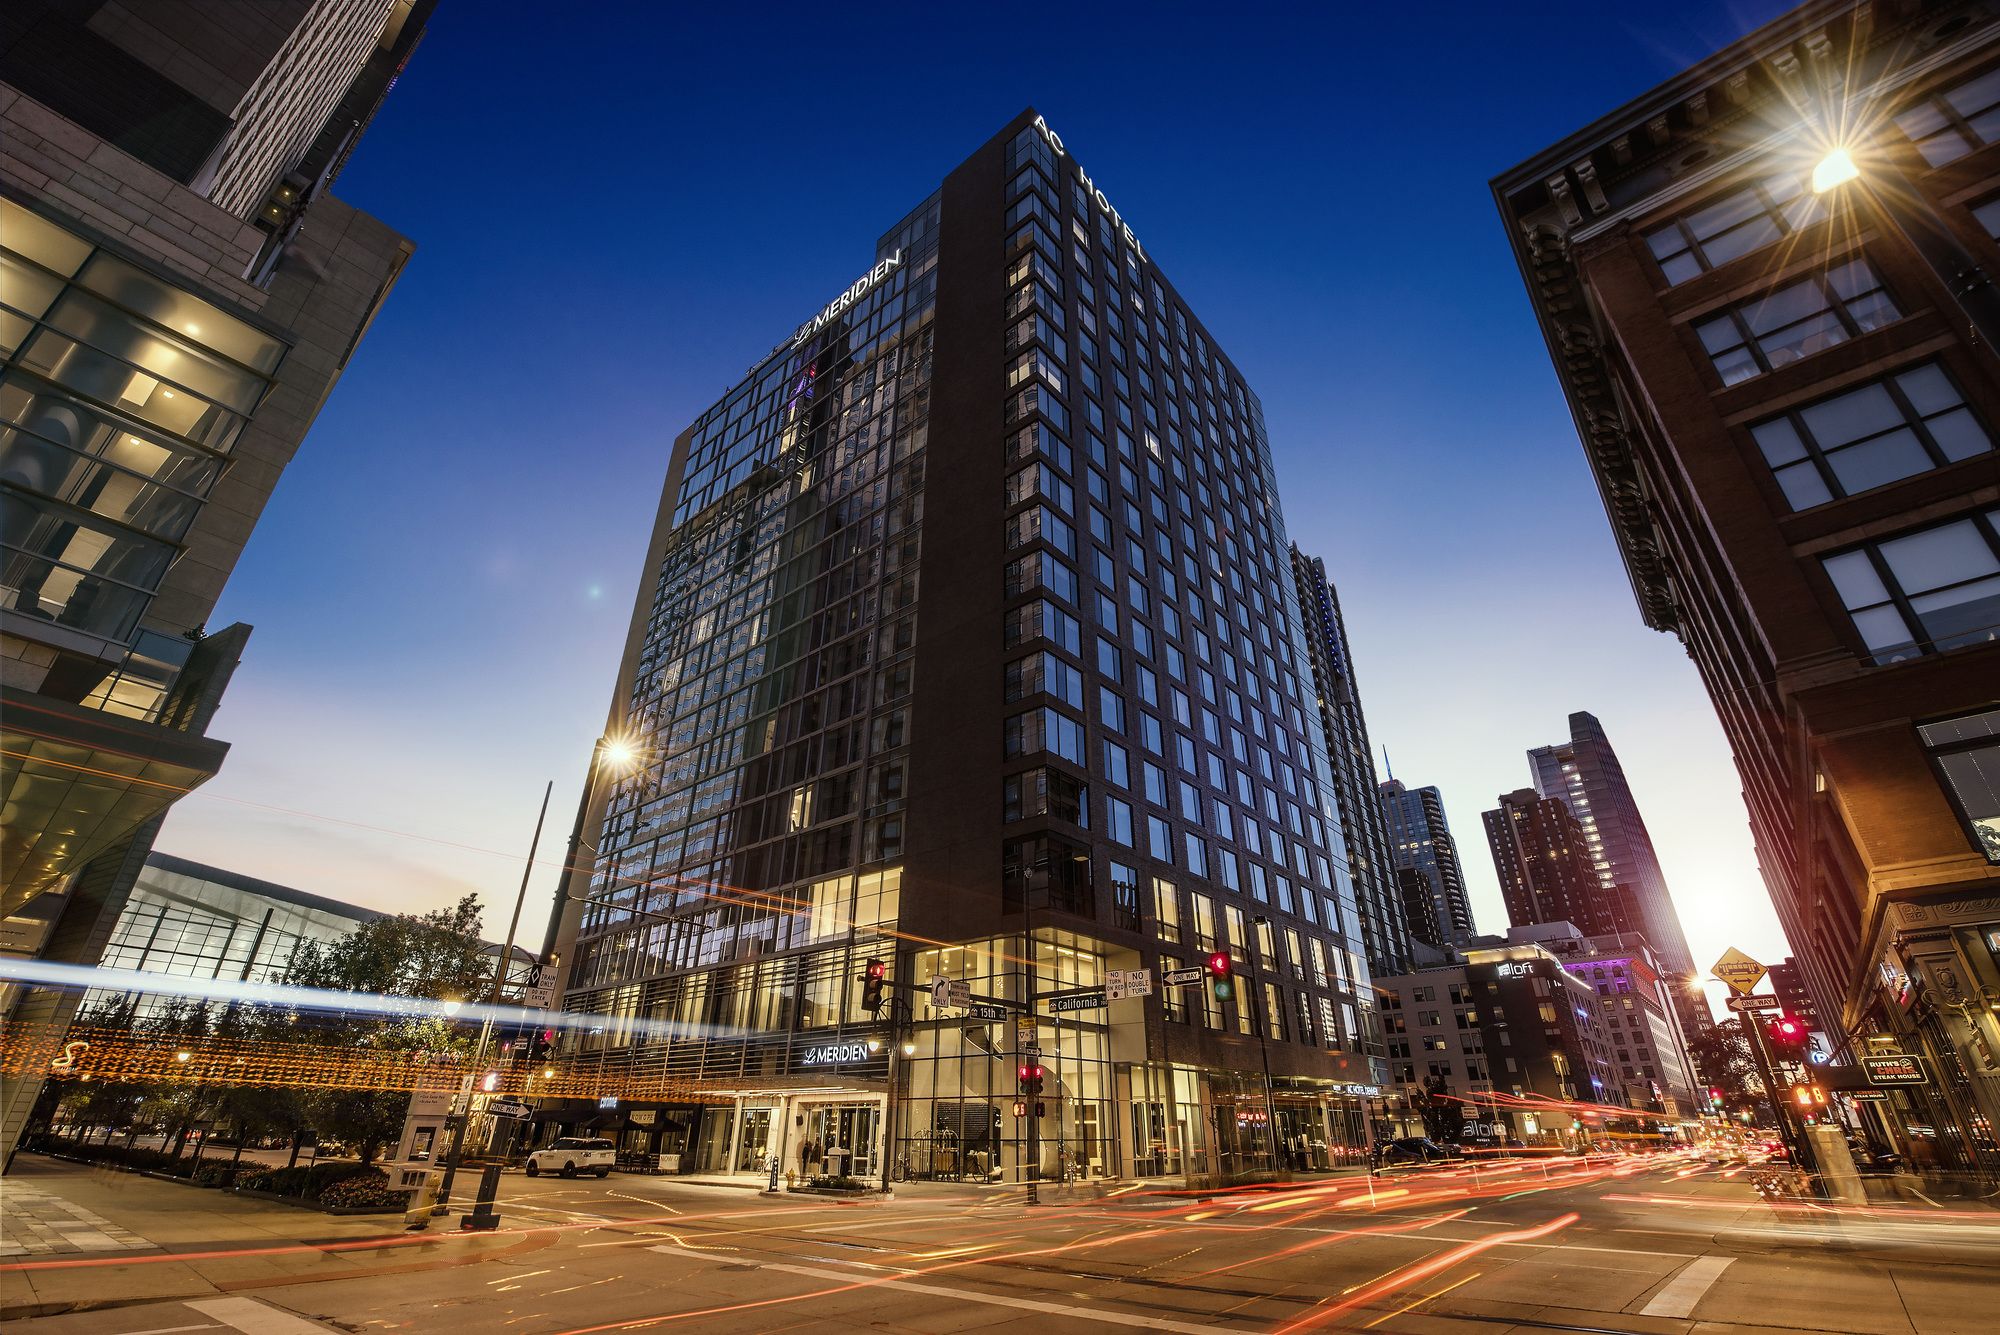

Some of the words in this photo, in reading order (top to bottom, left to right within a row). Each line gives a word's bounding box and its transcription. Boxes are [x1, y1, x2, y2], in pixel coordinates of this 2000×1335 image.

[1034, 114, 1064, 156] AC
[1080, 166, 1147, 264] HOTEL
[791, 321, 812, 350] Le
[813, 248, 901, 333] MERIDIEN
[1499, 962, 1533, 976] aloft
[1132, 972, 1144, 980] NO
[1128, 980, 1149, 988] DOUBLE
[933, 997, 946, 1005] ONLY
[1057, 996, 1098, 1010] California
[980, 1007, 996, 1018] 15th
[803, 1047, 816, 1064] Le
[816, 1044, 868, 1063] MERIDIEN
[1869, 1060, 1900, 1068] RUTH'S
[1876, 1065, 1915, 1075] CHRIS
[491, 1103, 504, 1112] ONE
[505, 1105, 520, 1114] WAY
[1463, 1120, 1496, 1136] alo
